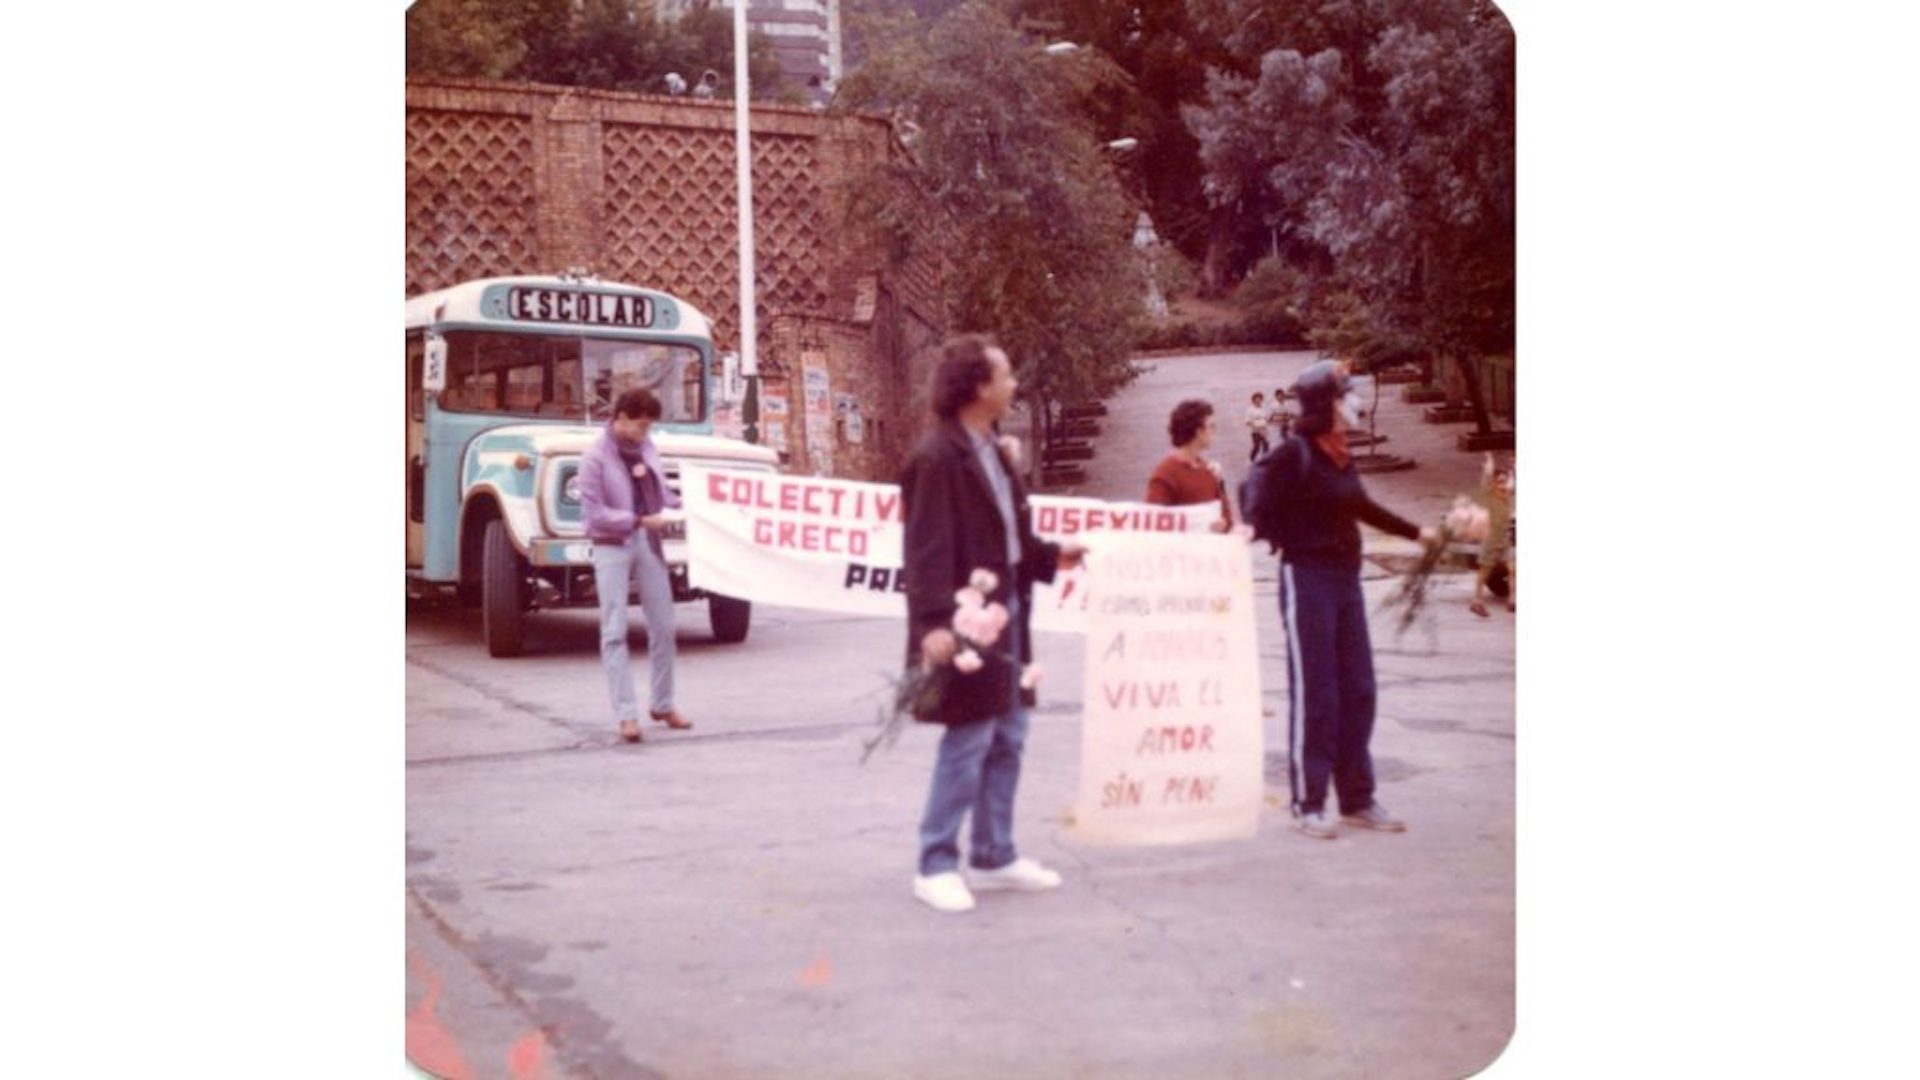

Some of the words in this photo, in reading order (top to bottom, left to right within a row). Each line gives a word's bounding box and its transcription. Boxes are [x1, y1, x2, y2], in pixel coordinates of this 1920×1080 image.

[518, 287, 646, 326] ESCOLAR
[707, 473, 904, 522] COLECTIV
[1103, 681, 1182, 710] VIVA
[1136, 724, 1216, 756] AMOR
[1162, 776, 1220, 804] PENE
